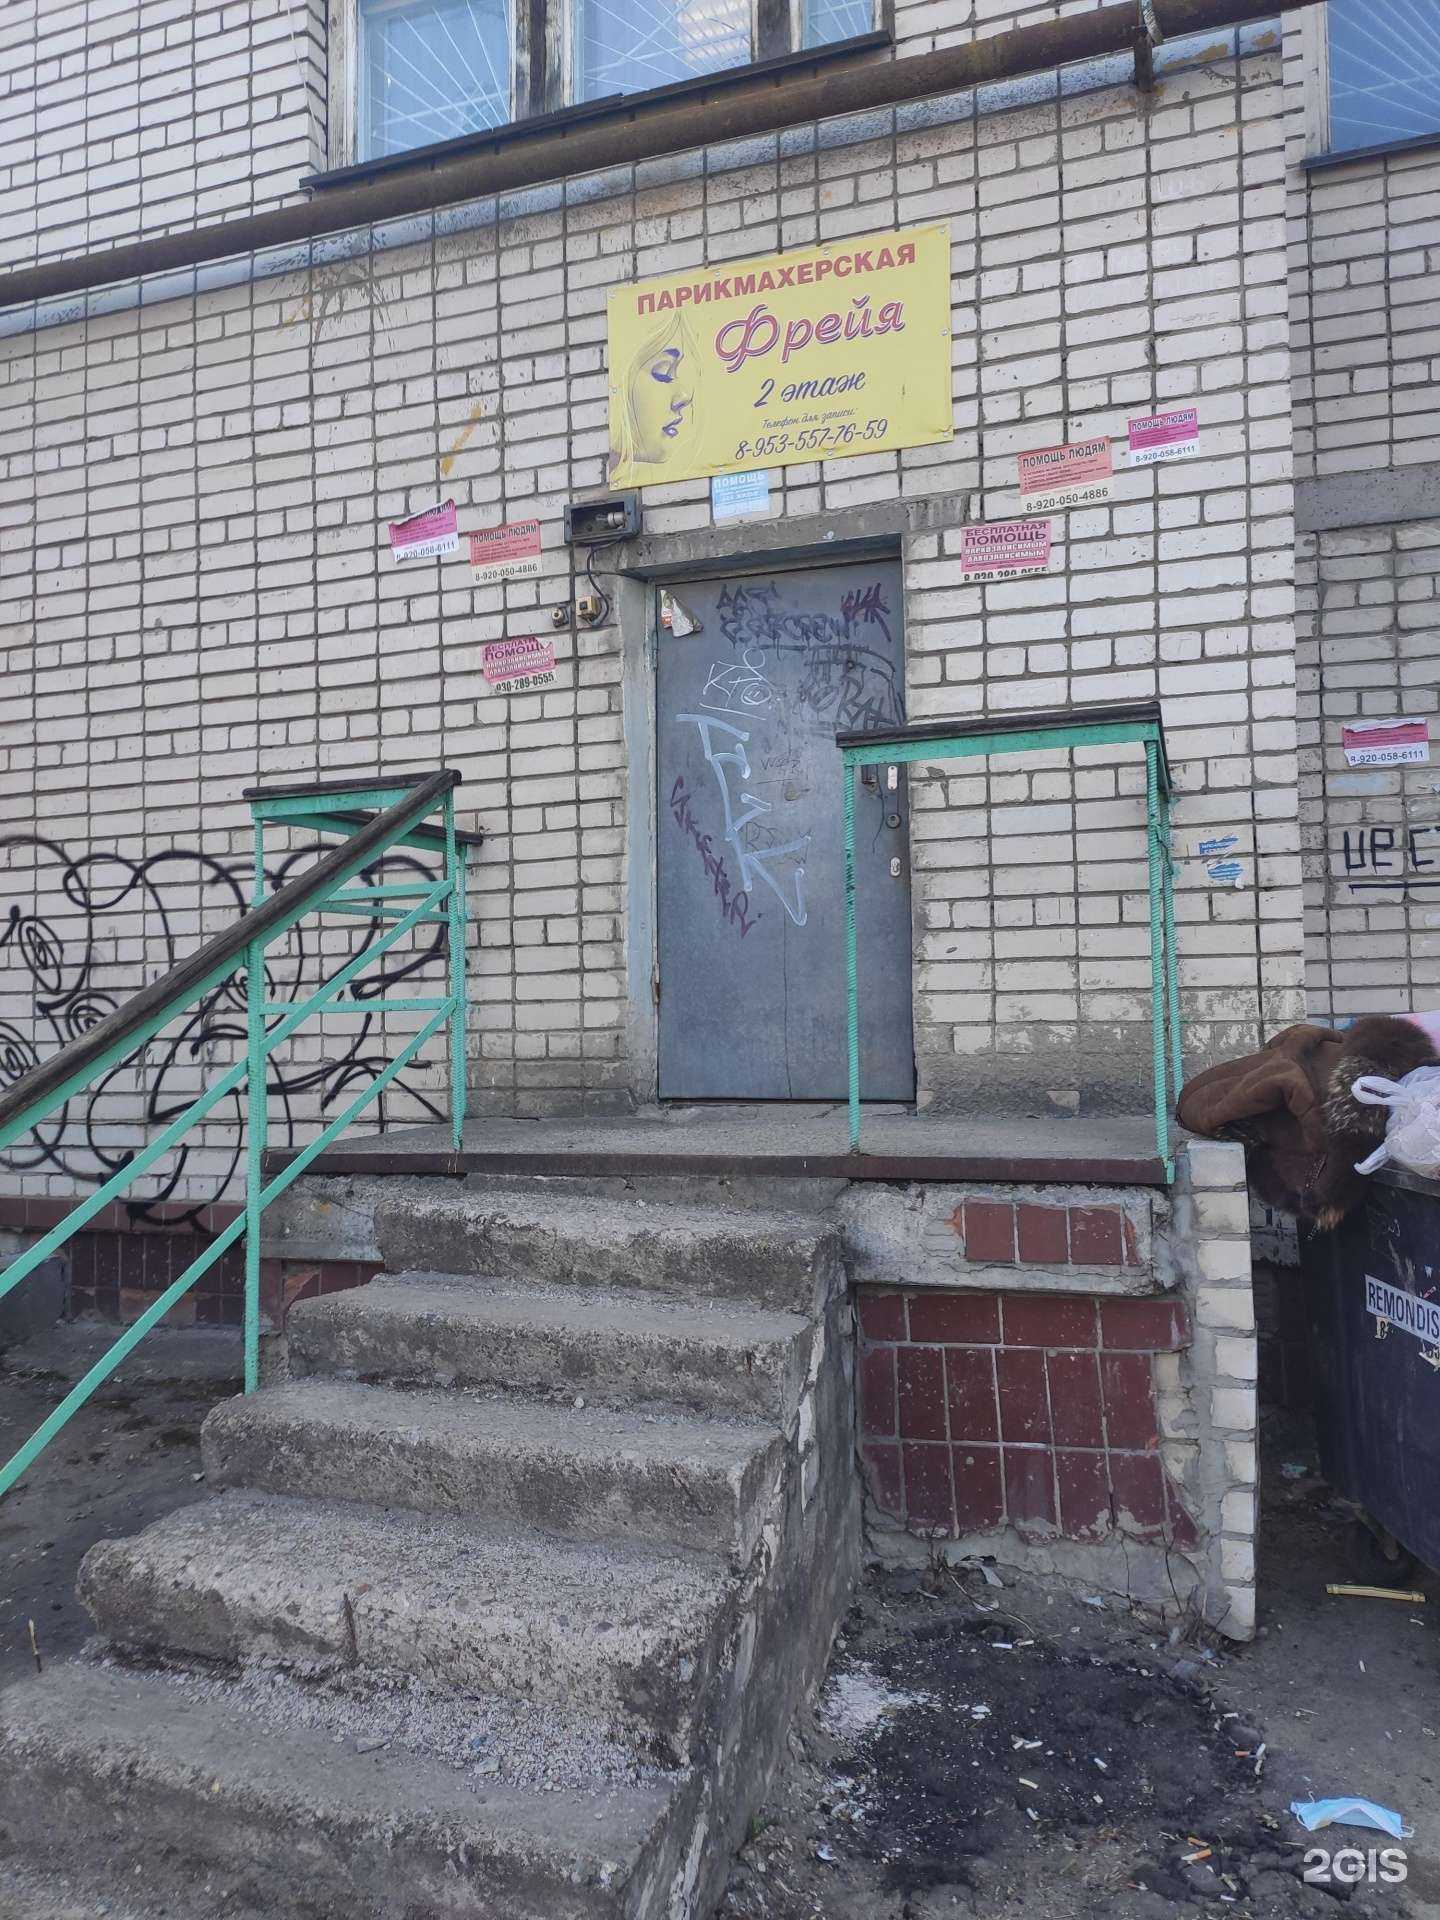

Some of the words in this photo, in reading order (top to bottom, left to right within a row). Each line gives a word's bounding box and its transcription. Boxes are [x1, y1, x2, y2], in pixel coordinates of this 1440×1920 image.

[637, 243, 916, 315] ПАРИКМАХЕРСКАЯ
[715, 295, 905, 373] Фрейя
[754, 378, 775, 408] 2
[781, 372, 866, 403] этаж
[762, 417, 800, 430] Телефон
[801, 412, 819, 424] для
[1133, 418, 1163, 431] ПОМОЩЬ
[1166, 412, 1194, 424] ЛЮДЯМ
[735, 419, 888, 460] 8-953-557-76-59
[1023, 451, 1066, 467] ПОМОЩЬ
[1068, 442, 1106, 459] ЛЮДЯМ
[1026, 487, 1108, 511] 8-920-050-4886
[473, 531, 506, 544] ПОМОЩЬ
[508, 524, 537, 537] ЛЮДЯМ
[965, 531, 1047, 547] ПОМОЩЬ
[966, 523, 1047, 537] БЕСПЛАТНАЯ
[1350, 750, 1424, 763] 8-920-058-6111
[1368, 1282, 1440, 1339] REMONDIS
